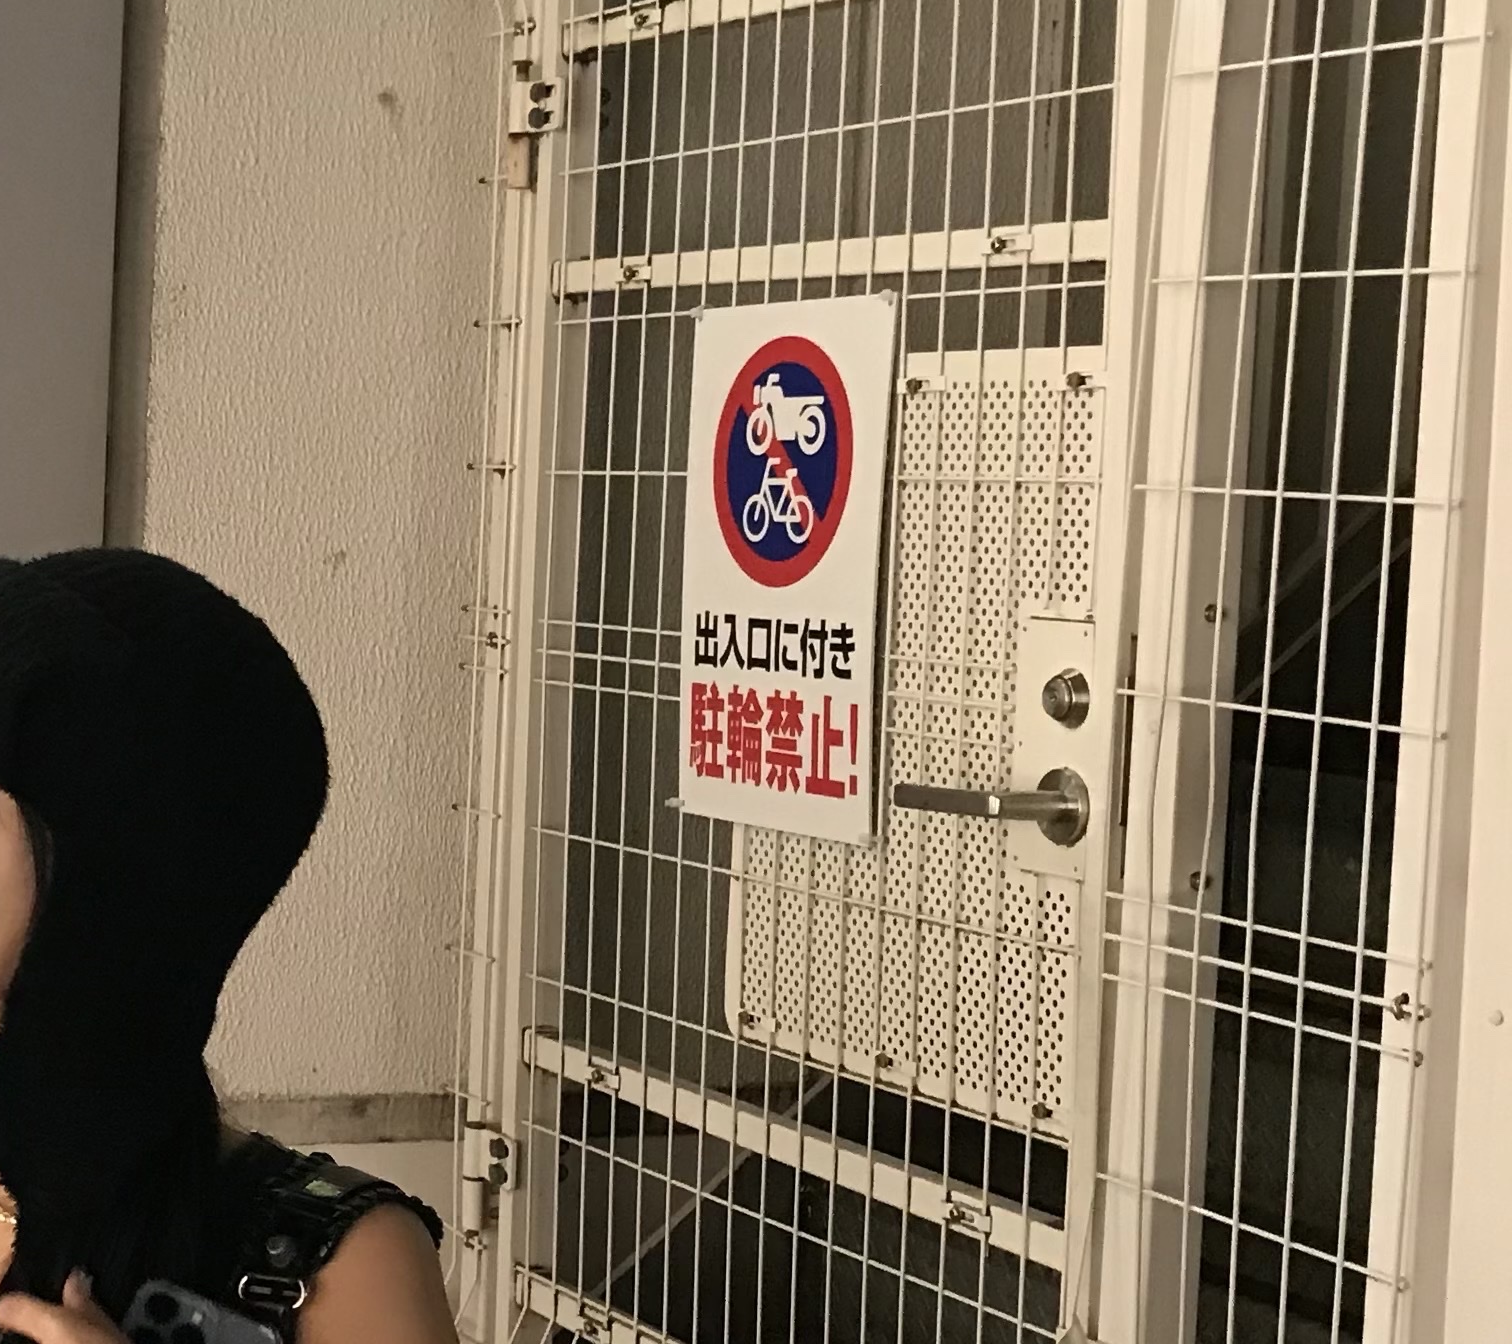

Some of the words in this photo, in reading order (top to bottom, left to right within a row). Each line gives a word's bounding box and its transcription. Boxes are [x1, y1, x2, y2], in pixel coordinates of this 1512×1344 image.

[693, 610, 856, 680] 出入口に付き
[689, 680, 860, 799] 駐輪禁止!
